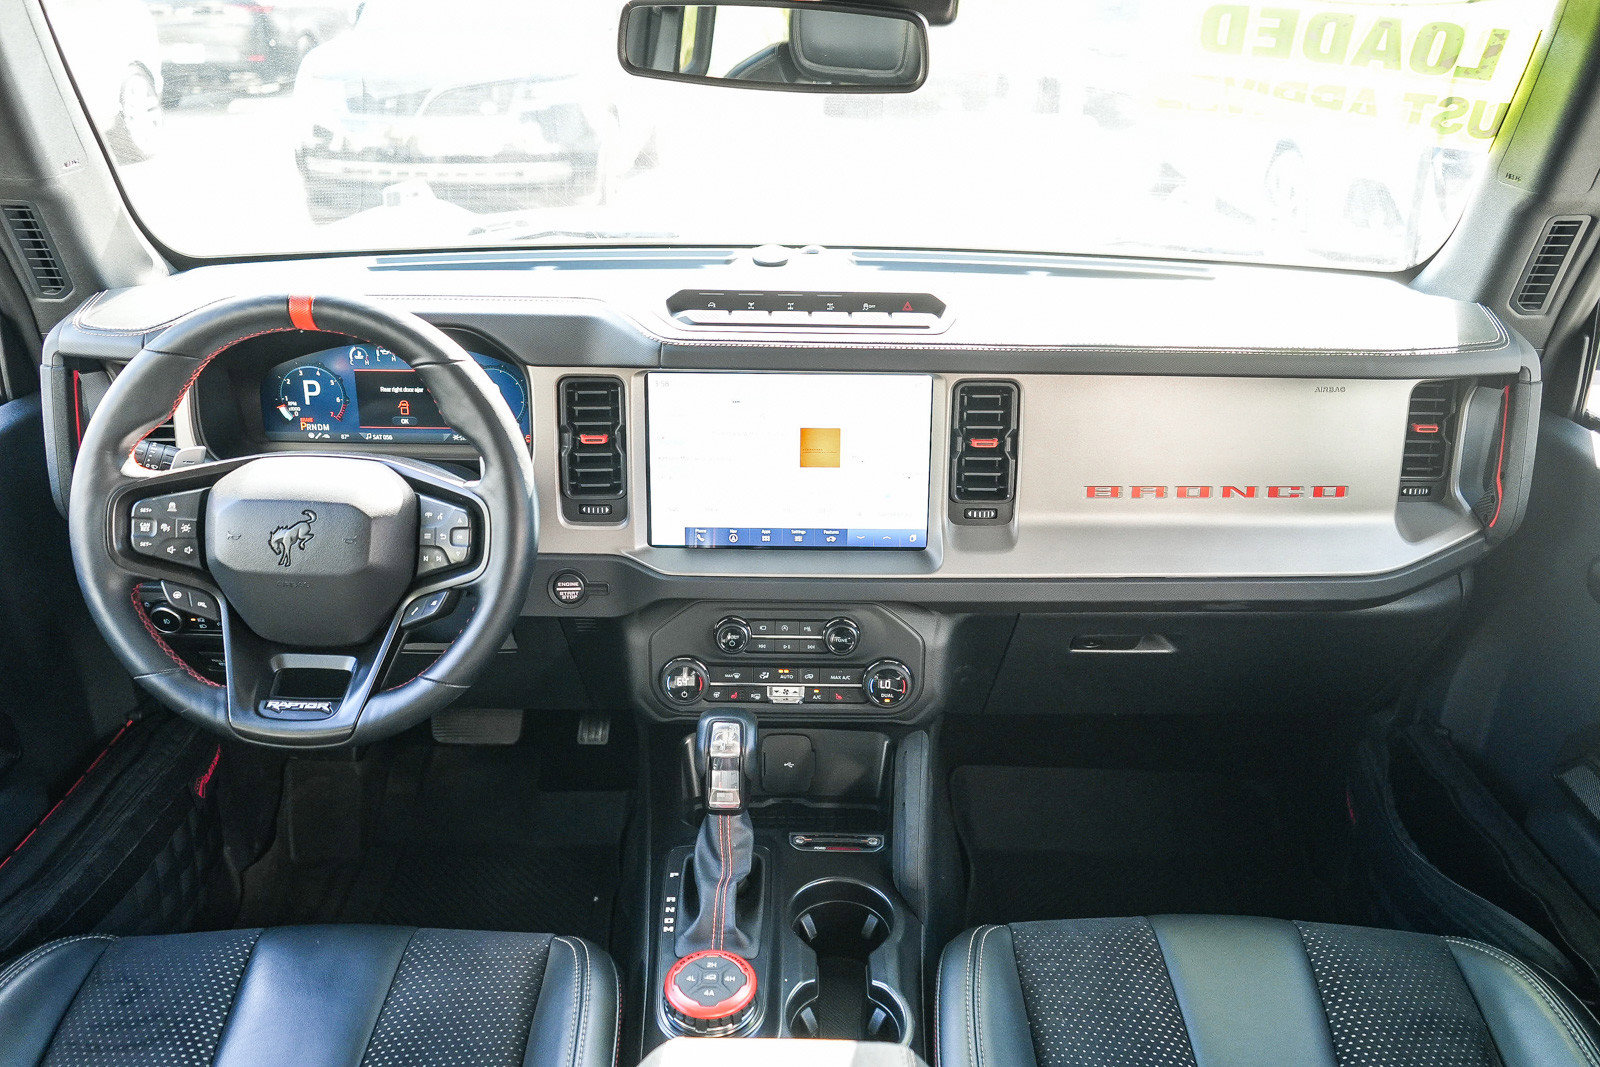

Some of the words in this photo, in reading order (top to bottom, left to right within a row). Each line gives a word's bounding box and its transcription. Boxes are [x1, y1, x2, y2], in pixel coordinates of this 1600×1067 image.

[302, 379, 321, 406] P
[1083, 485, 1350, 499] BRONCO
[265, 701, 333, 714] RAPTOR
[703, 989, 716, 997] 4A
